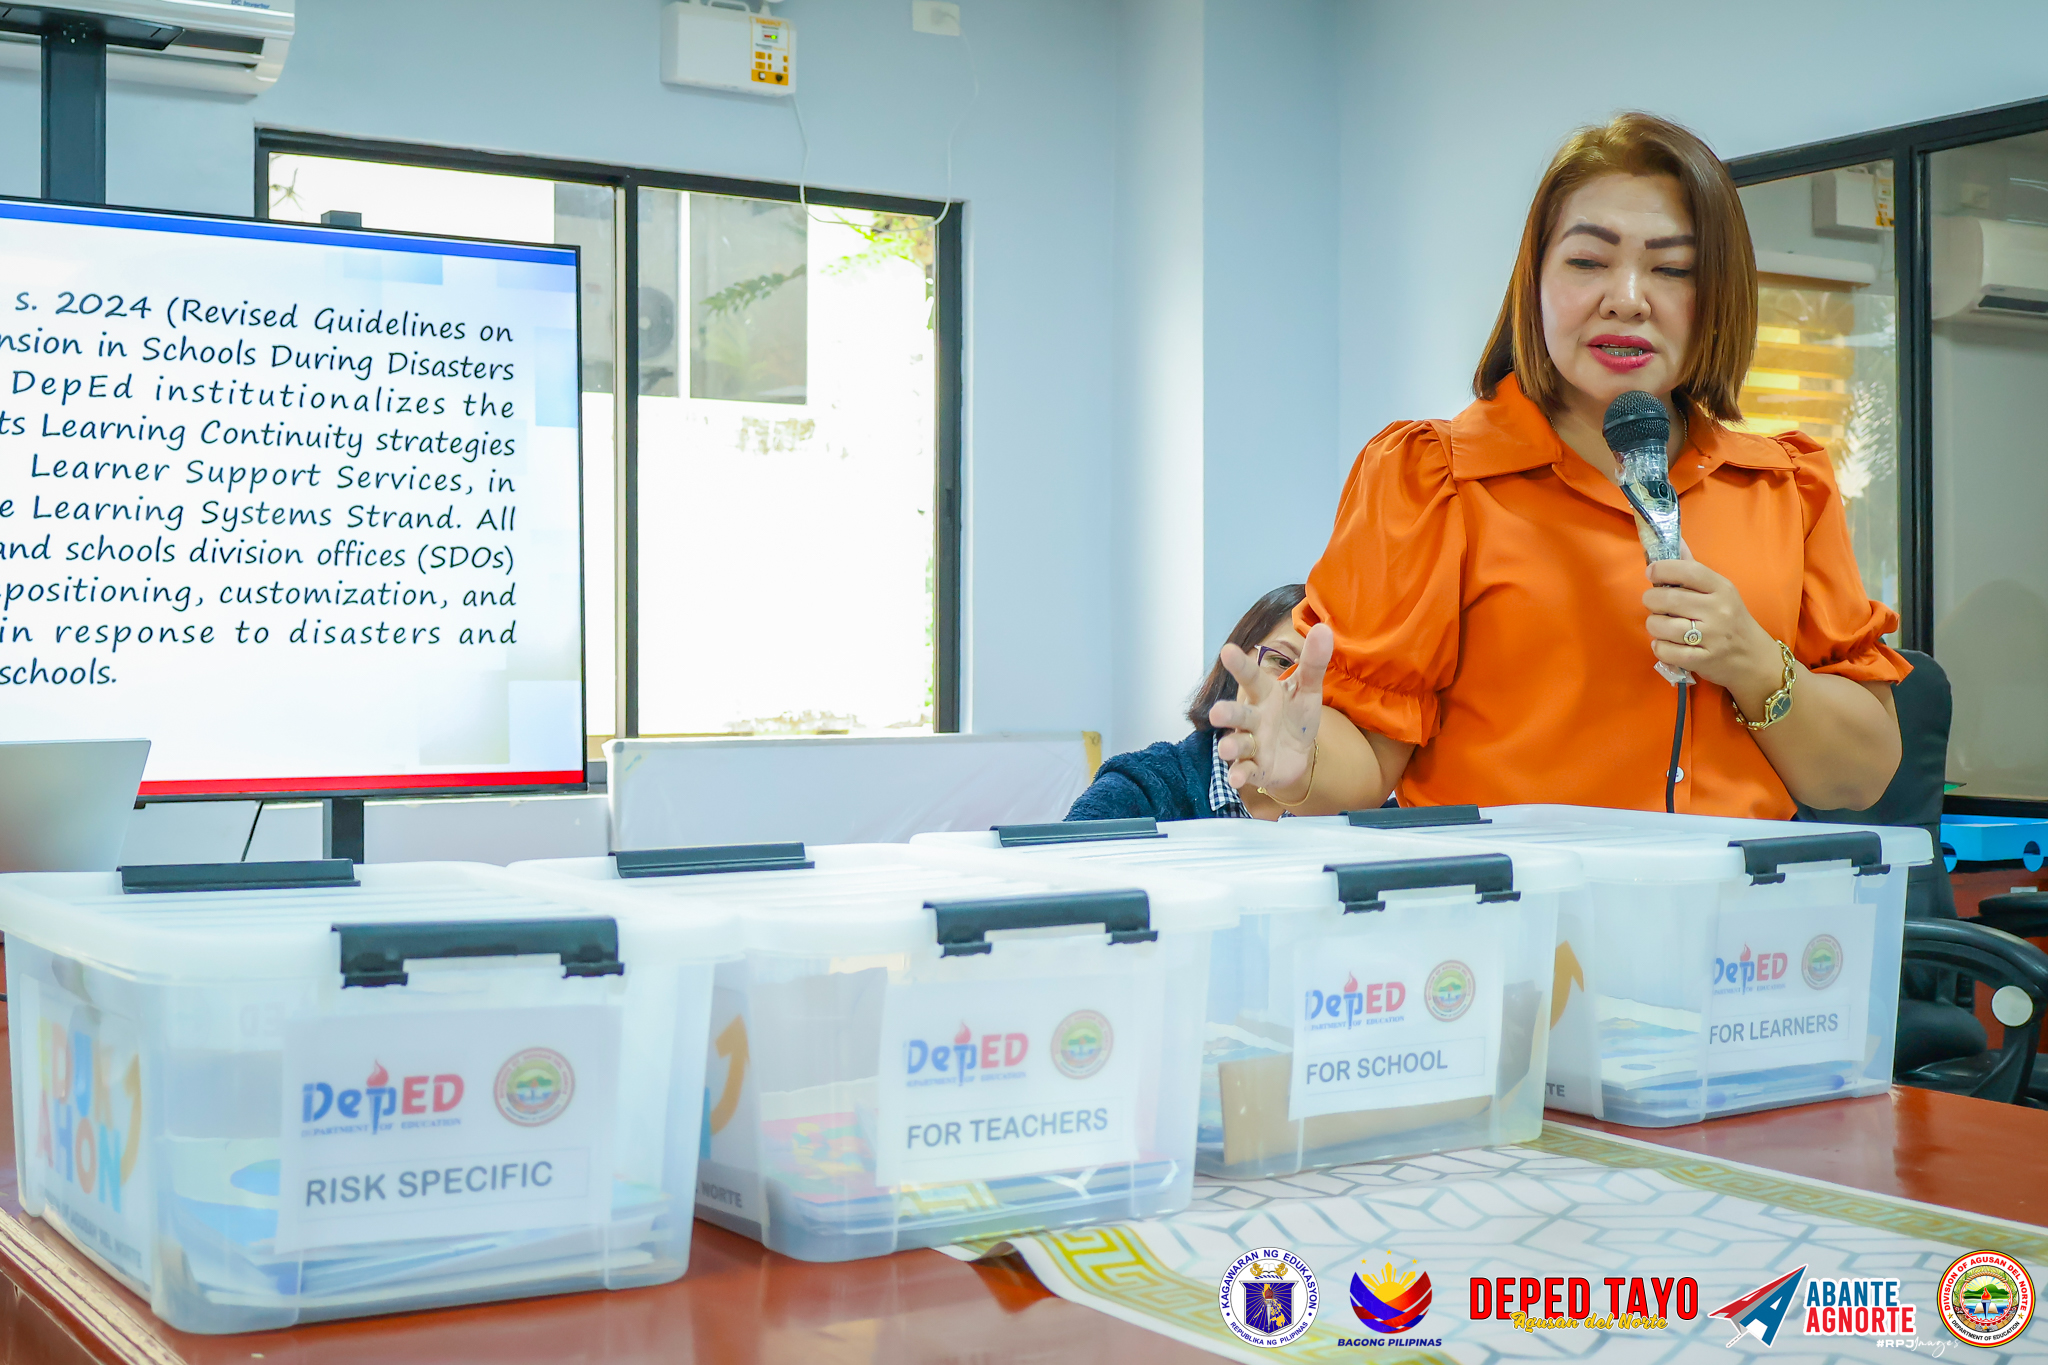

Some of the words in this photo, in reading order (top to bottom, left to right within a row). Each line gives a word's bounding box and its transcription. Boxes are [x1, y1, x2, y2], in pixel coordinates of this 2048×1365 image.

[15, 292, 37, 311] s.
[55, 291, 152, 319] 2024
[167, 296, 298, 329] (Revised
[314, 307, 466, 340] Guidelines
[479, 325, 514, 342] on
[98, 331, 128, 357] in
[142, 335, 256, 366] Schools
[271, 344, 373, 381] During
[388, 350, 514, 381] Disasters
[12, 370, 133, 406] DepEd
[155, 375, 445, 415] institutionalizes
[463, 392, 514, 419] the
[41, 413, 186, 451] Learning
[200, 419, 363, 459] Continuity
[376, 428, 515, 463] strategies
[31, 453, 170, 481] Learner
[186, 459, 321, 494] Support
[337, 465, 473, 495] Services,
[489, 468, 515, 493] in
[33, 495, 184, 531] Learning
[201, 500, 332, 533] Systems
[347, 504, 461, 529] Strand.
[476, 505, 516, 531] All
[65, 534, 175, 563] schools
[189, 537, 304, 565] division
[317, 539, 406, 567] offices
[418, 544, 514, 576] (SDOs)
[219, 580, 448, 609] customization,
[462, 582, 517, 607] and
[0, 616, 33, 643] in
[56, 624, 215, 653] response
[235, 620, 269, 644] to
[289, 618, 440, 645] disasters
[459, 620, 517, 645] and
[0, 657, 117, 685] schools.
[1305, 981, 1406, 1030] DepED
[1353, 1019, 1362, 1027] OF
[1366, 1015, 1405, 1025] EDUCATION
[1709, 1022, 1745, 1044] FOR
[1749, 1013, 1839, 1041] LEARNERS
[906, 1032, 1029, 1086] DepED
[1306, 1061, 1351, 1084] FOR
[1357, 1049, 1449, 1079] SCHOOL
[302, 1073, 465, 1135] DepED
[379, 1122, 394, 1132] OF
[401, 1117, 462, 1130] EDUCATION
[905, 1120, 962, 1149] FOR
[969, 1107, 1108, 1143] TEACHERS
[305, 1173, 387, 1207] RISK
[397, 1160, 554, 1199] SPECIFIC
